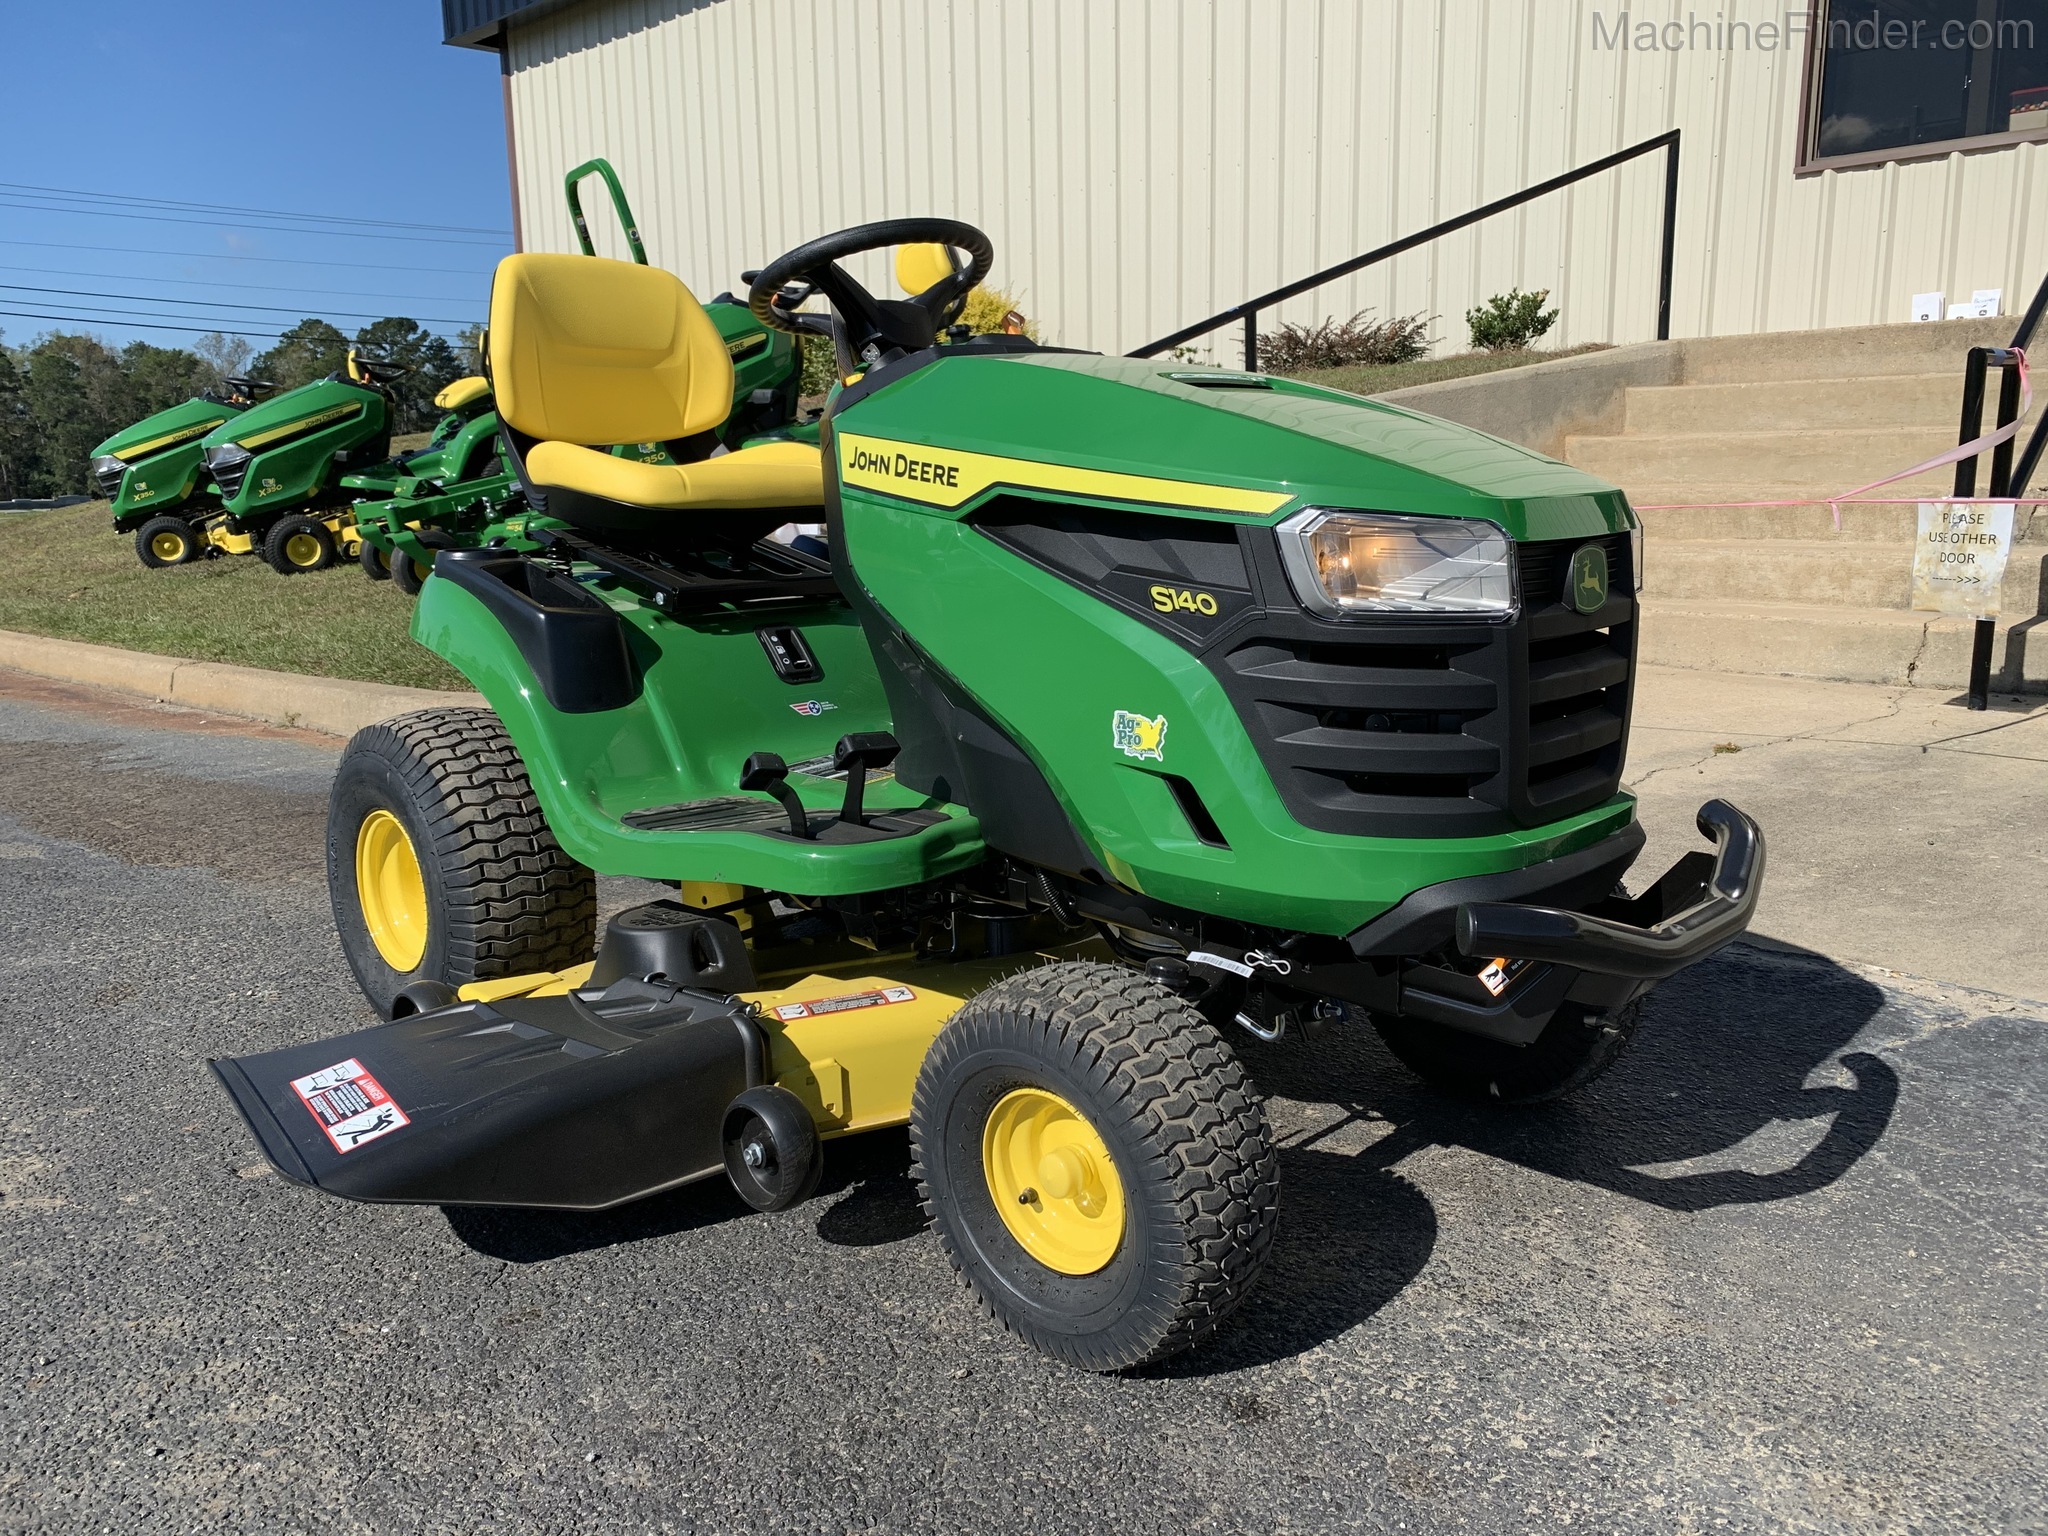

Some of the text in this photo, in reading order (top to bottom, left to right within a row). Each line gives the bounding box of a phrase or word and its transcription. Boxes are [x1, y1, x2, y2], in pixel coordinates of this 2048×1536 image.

[728, 341, 746, 354] ERE
[304, 409, 344, 427] JOHN DEERE
[172, 424, 208, 441] JOHN DEERE
[848, 446, 960, 488] JOHN DEERE
[133, 490, 155, 502] X350
[258, 484, 283, 498] X350
[1942, 512, 1985, 525] PLEASE
[1928, 532, 1997, 545] USE OTHER
[1940, 551, 1975, 564] DOOR
[1149, 585, 1218, 616] S140
[1116, 714, 1141, 734] Ag-
[1117, 729, 1142, 746] Pro
[364, 1080, 385, 1102] DANGER
